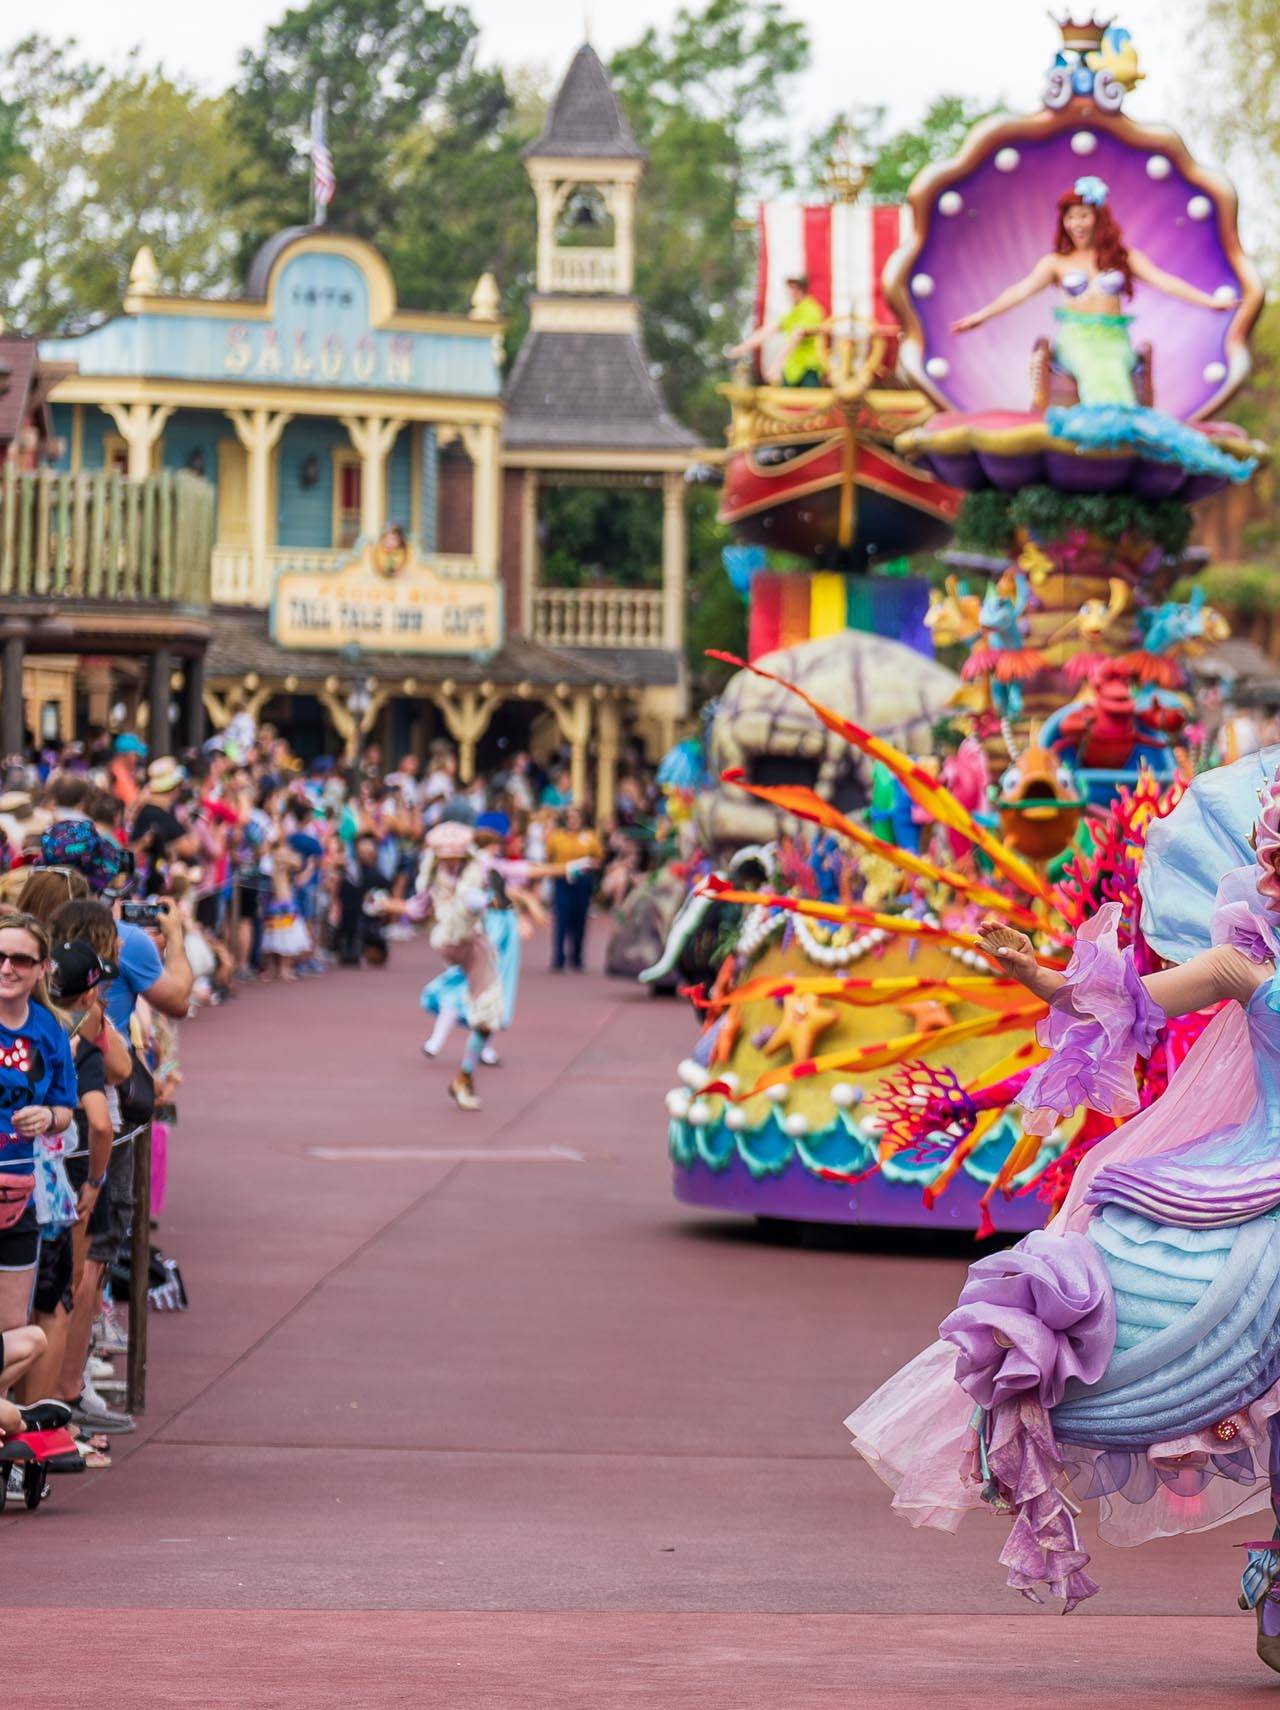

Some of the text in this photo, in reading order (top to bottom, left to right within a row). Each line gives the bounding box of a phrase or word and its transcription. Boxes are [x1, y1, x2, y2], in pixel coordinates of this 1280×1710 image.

[224, 324, 414, 382] SALOON
[288, 596, 332, 630] TALL
[338, 601, 384, 632] TALE
[391, 606, 422, 632] INN
